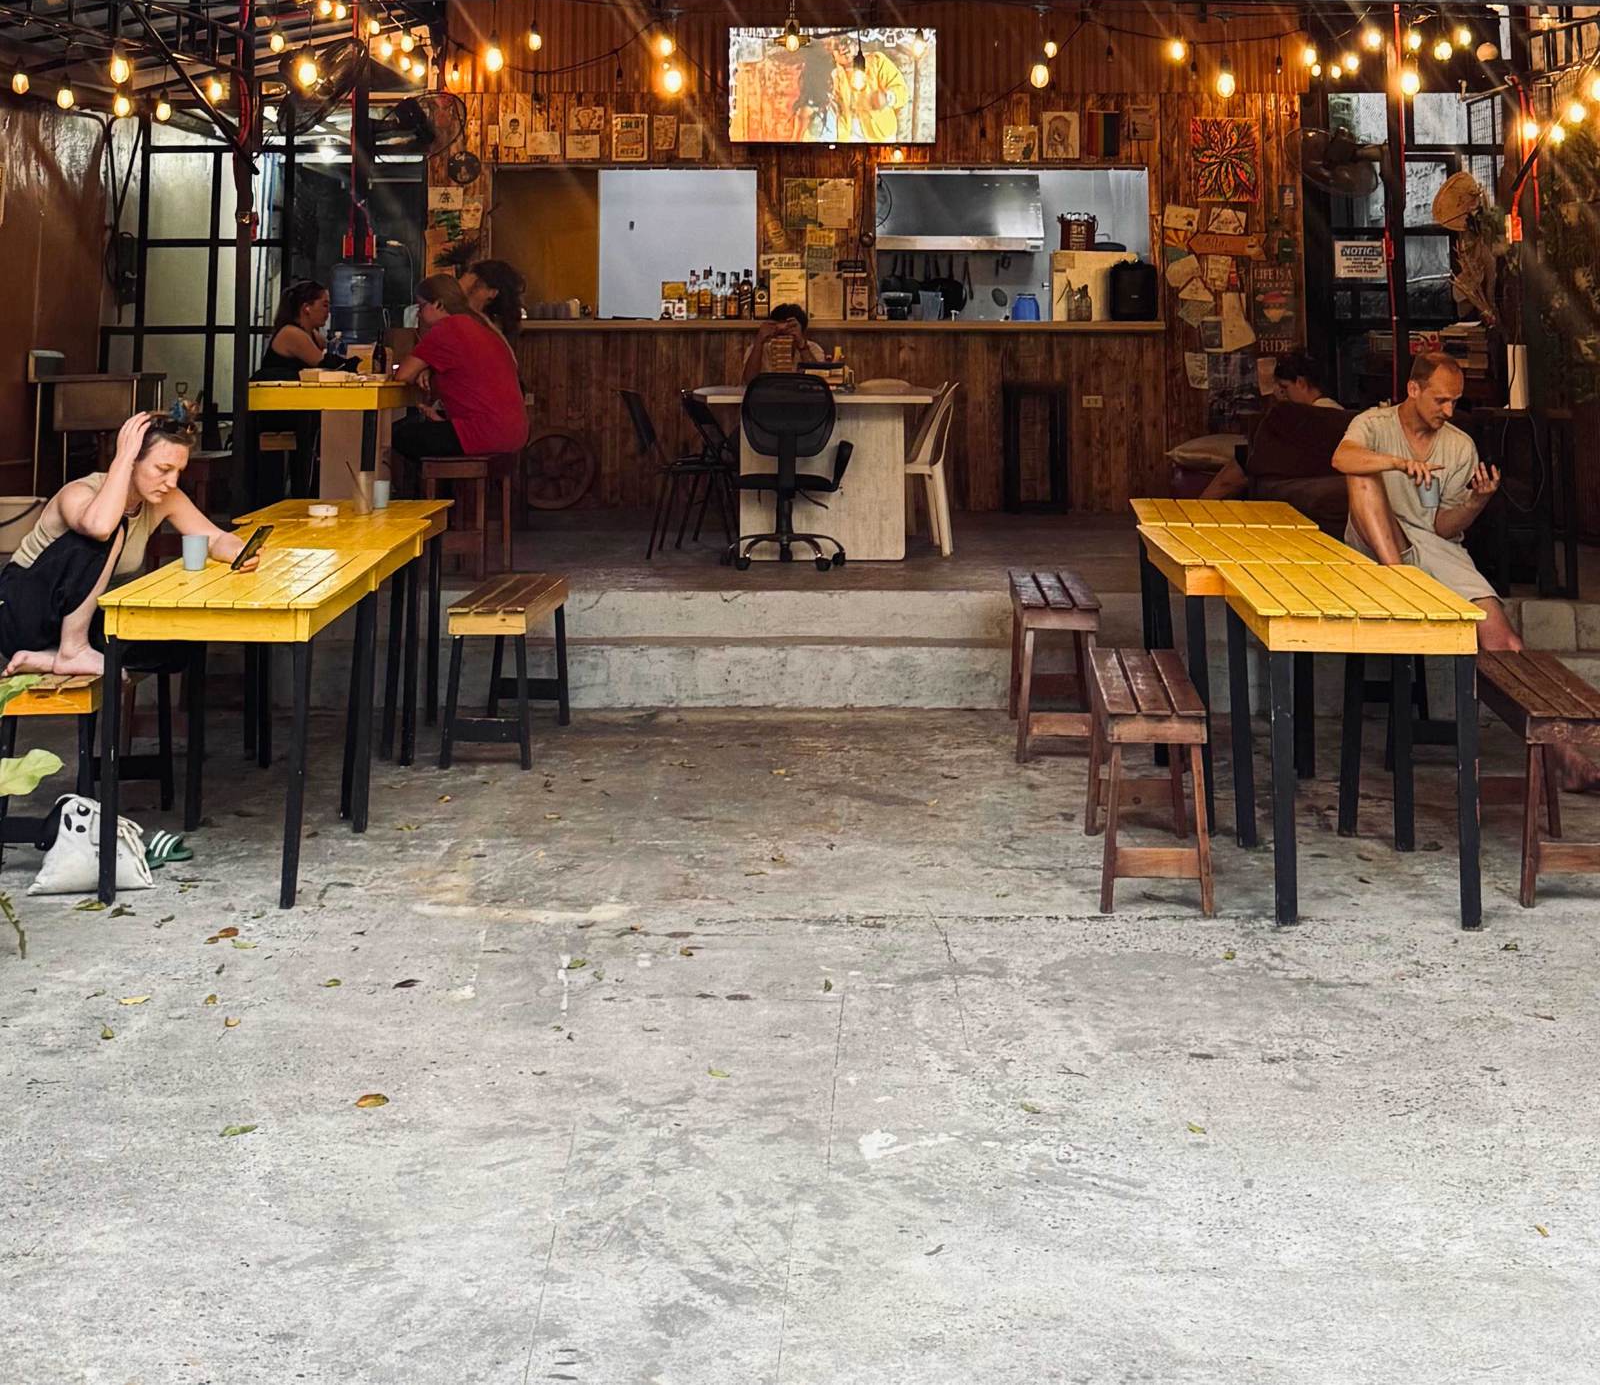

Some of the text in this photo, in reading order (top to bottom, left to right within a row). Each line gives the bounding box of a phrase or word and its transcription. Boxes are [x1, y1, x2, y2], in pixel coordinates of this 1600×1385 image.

[1254, 268, 1293, 280] LIFE IS A
[1260, 339, 1292, 352] RIDE
